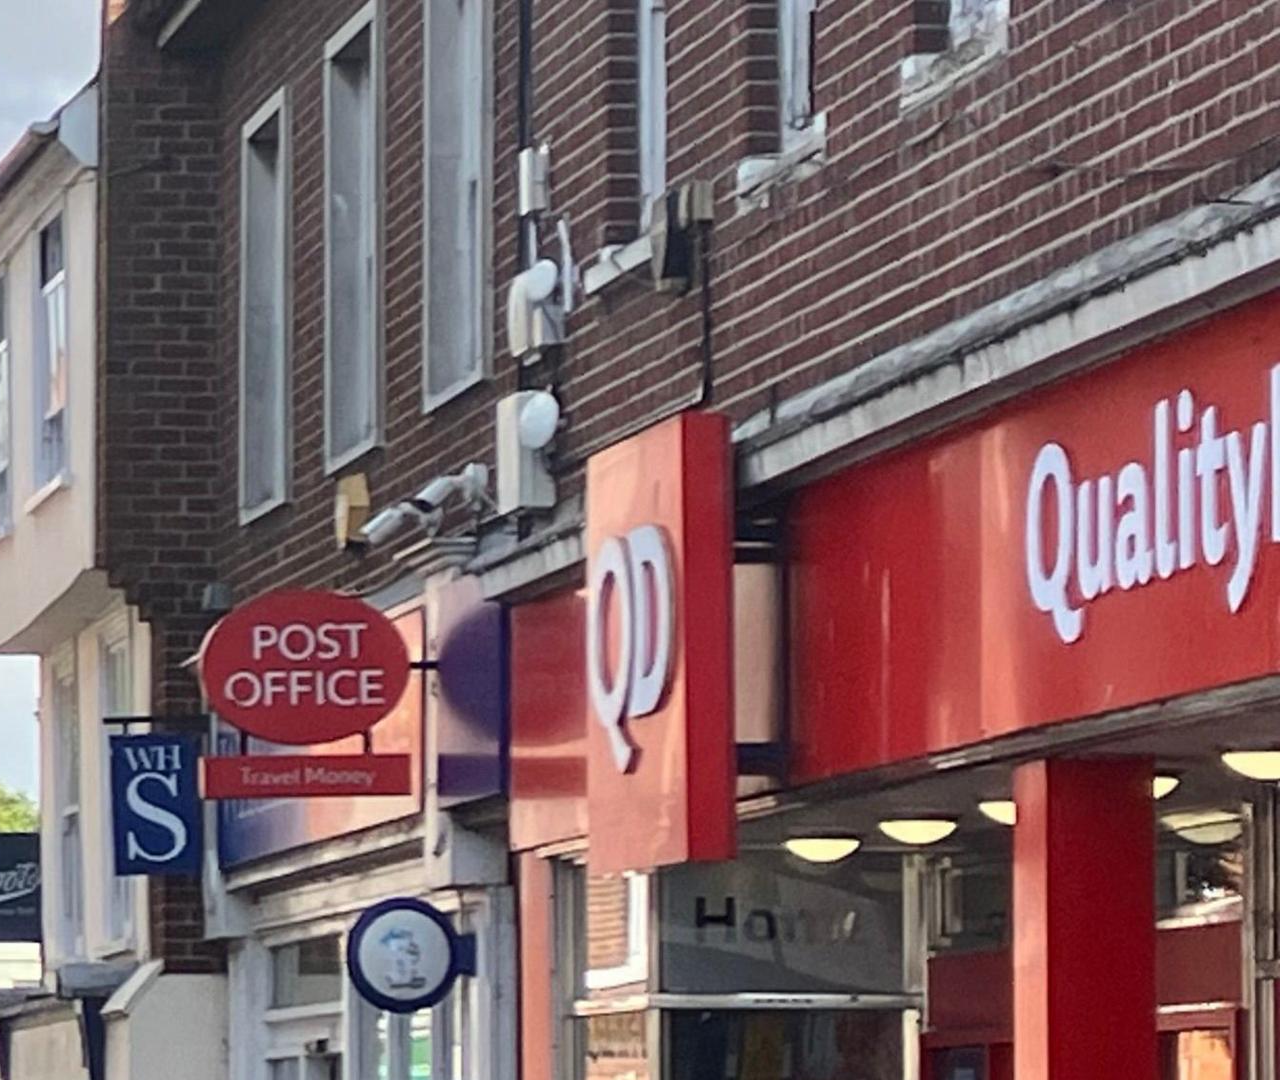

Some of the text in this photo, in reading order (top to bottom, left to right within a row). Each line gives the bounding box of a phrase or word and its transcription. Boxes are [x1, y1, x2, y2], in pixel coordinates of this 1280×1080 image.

[1026, 364, 1280, 644] Quality
[252, 623, 367, 660] POST
[587, 523, 673, 774] QD
[224, 669, 386, 707] OFFICE
[124, 745, 182, 771] WH
[240, 766, 376, 787] Travel Money
[126, 772, 187, 862] S
